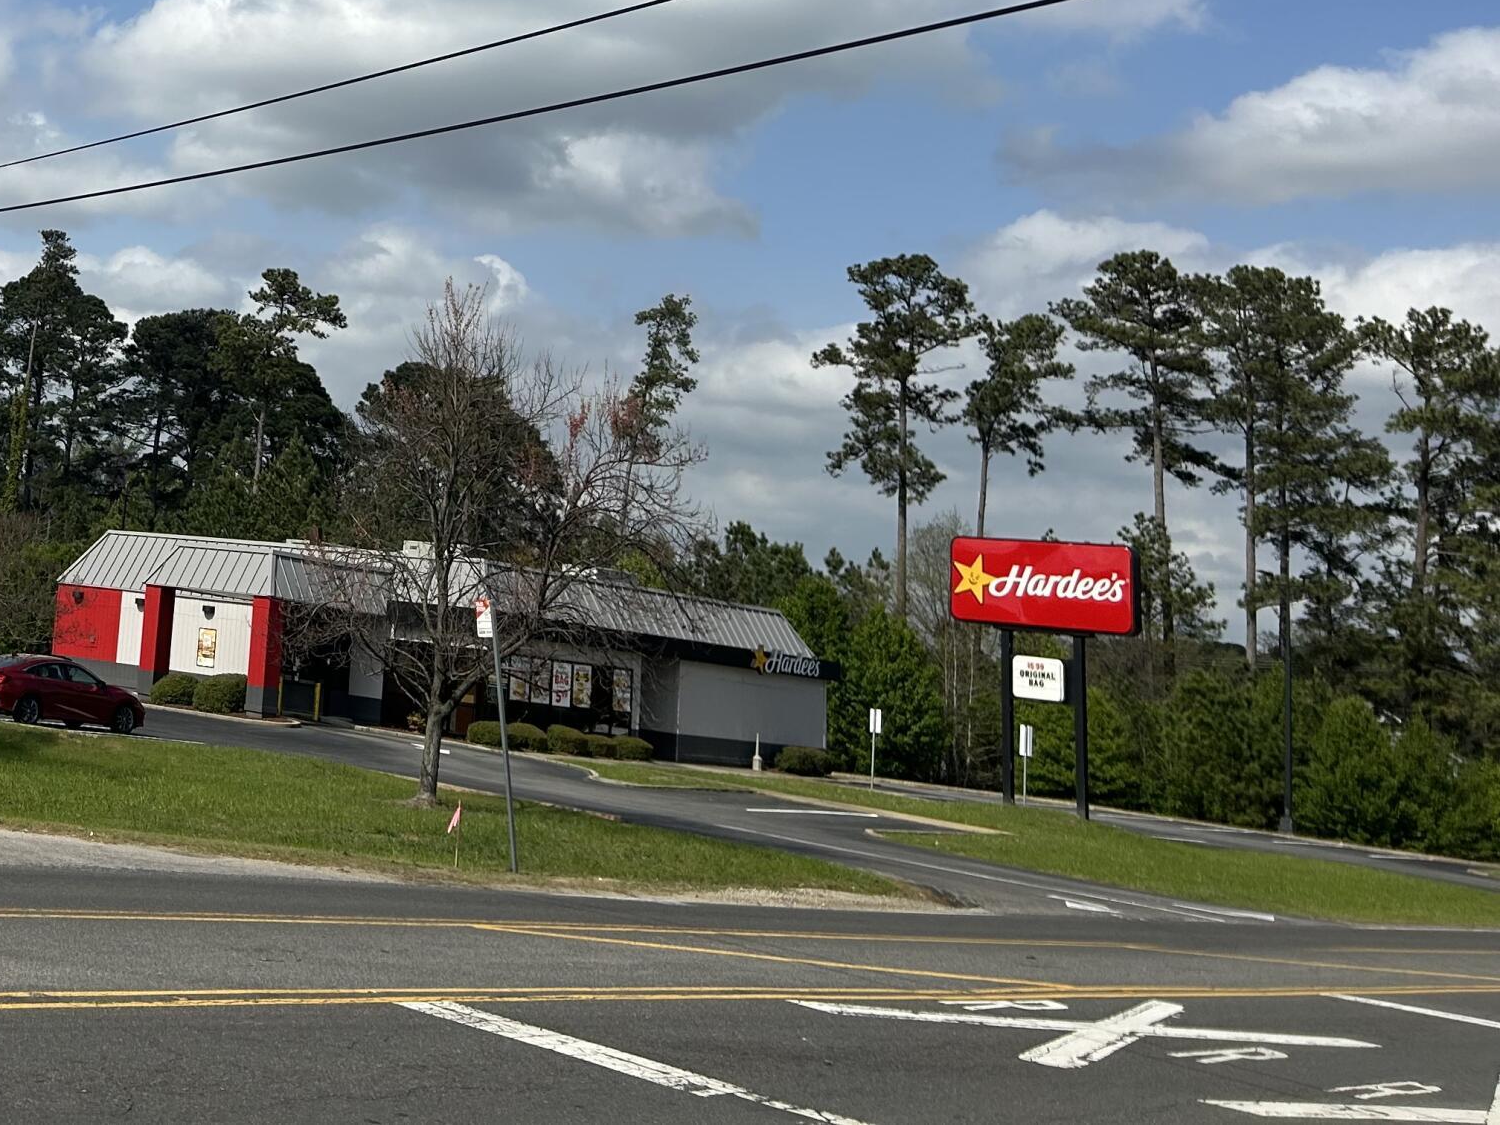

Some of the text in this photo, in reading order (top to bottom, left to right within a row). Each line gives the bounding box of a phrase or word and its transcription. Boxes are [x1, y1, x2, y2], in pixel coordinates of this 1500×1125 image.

[988, 564, 1126, 602] Hardee's
[1019, 669, 1056, 681] ORIGINAL
[1028, 678, 1045, 688] BAG
